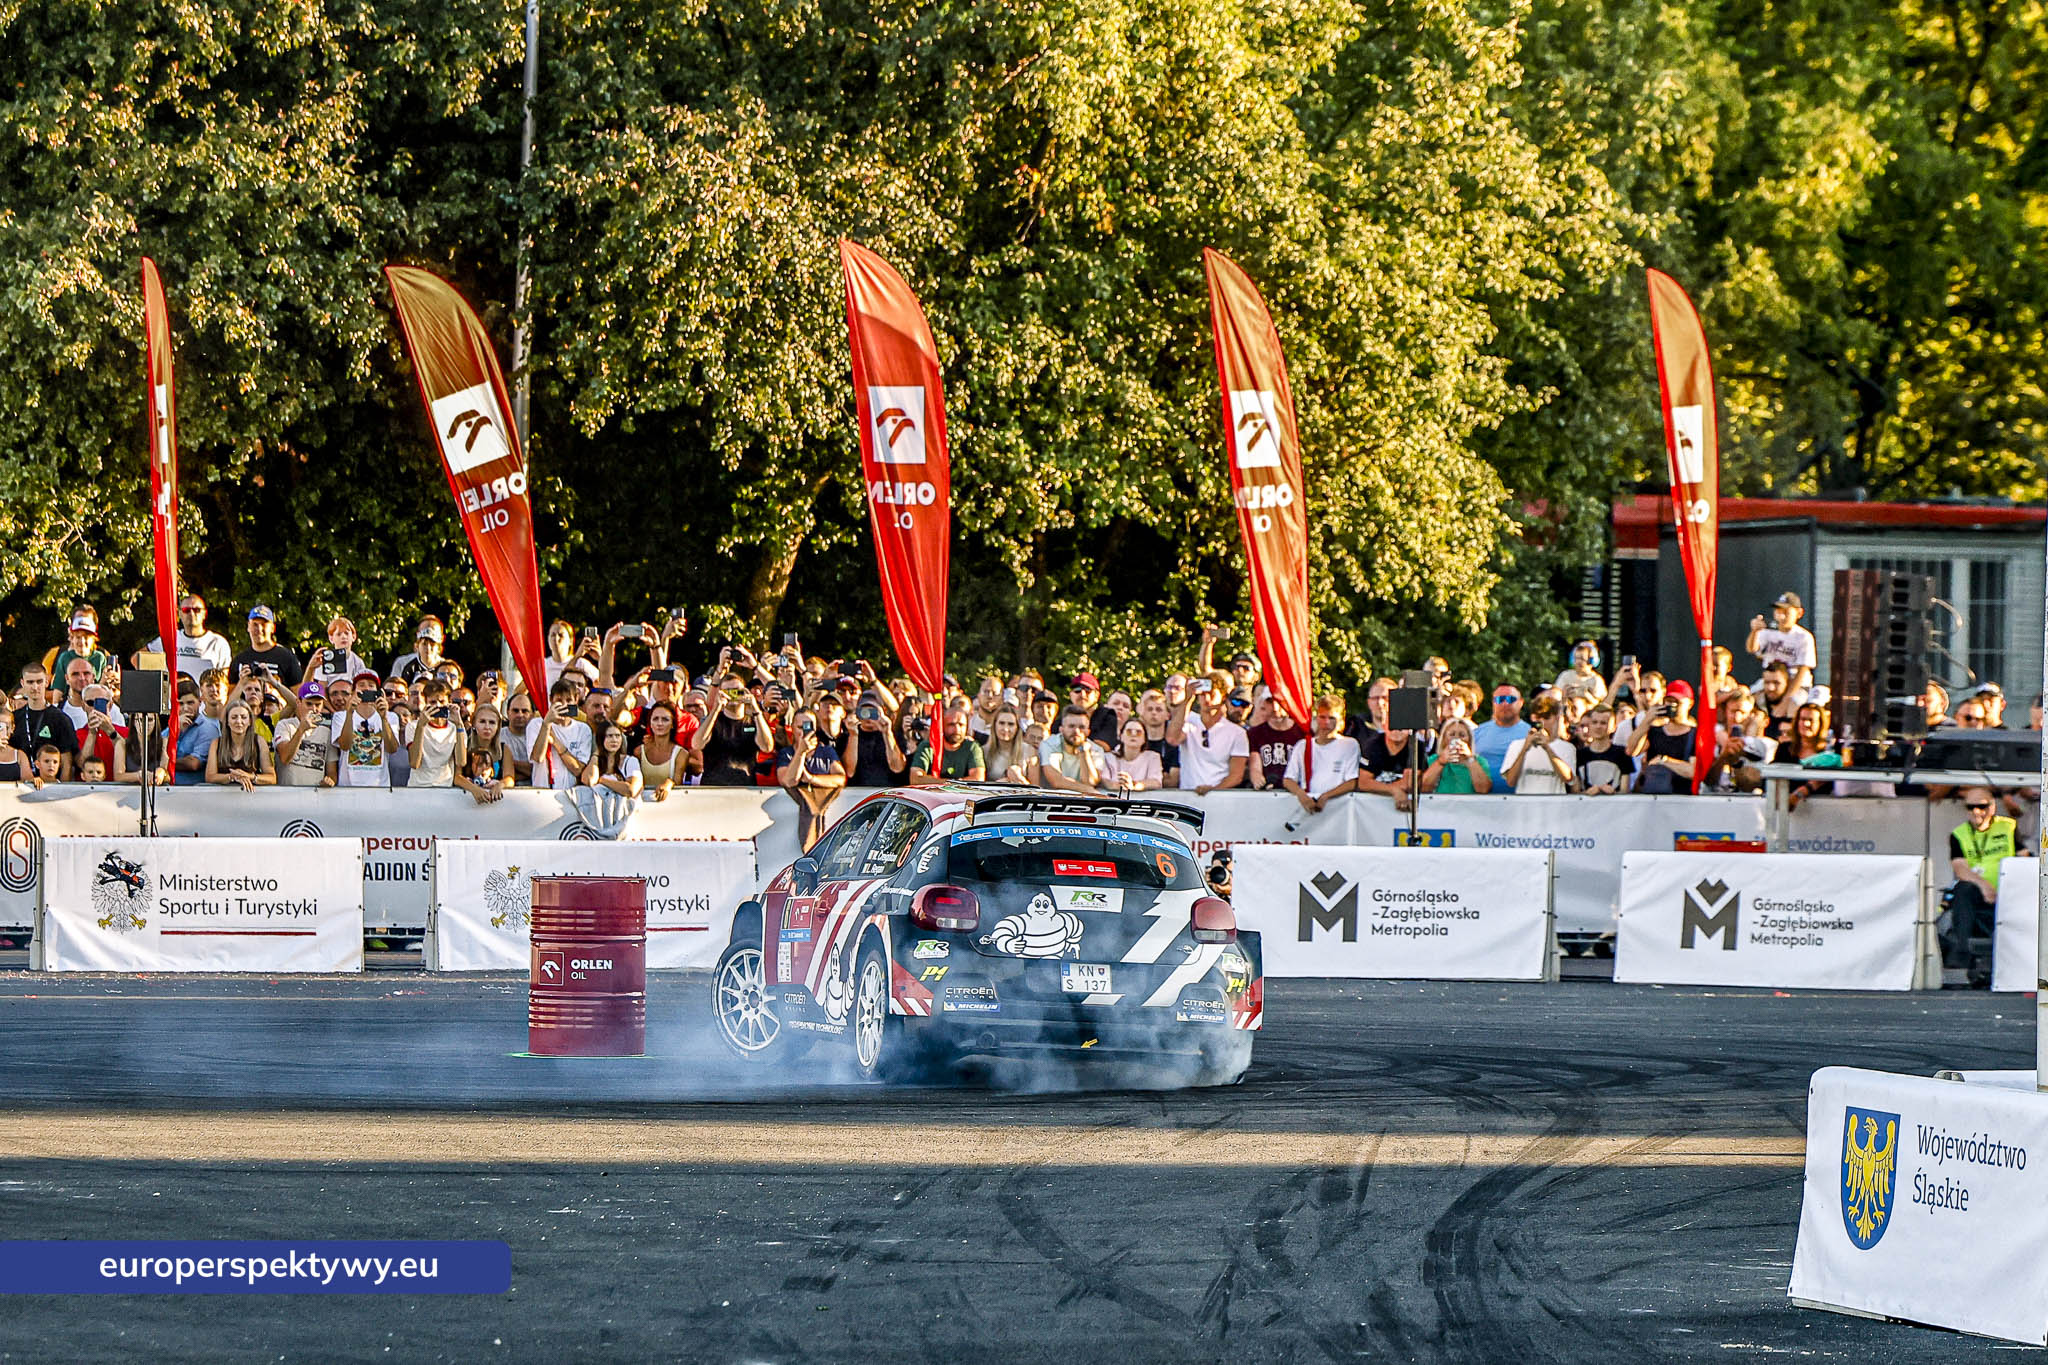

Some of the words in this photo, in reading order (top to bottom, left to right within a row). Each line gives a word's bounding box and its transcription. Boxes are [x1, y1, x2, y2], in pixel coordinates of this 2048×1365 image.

[1013, 827, 1051, 835] FOLLOW
[1069, 828, 1082, 836] ON
[1475, 832, 1595, 849] Województwo
[897, 832, 918, 868] 6
[1156, 853, 1177, 878] 6
[160, 874, 278, 892] Ministerstwo
[1372, 889, 1460, 906] Górnośląsko
[159, 898, 219, 919] Sportu
[225, 898, 230, 915] i
[235, 898, 318, 919] Turystyki
[1372, 906, 1480, 922] -Zagłębiowska
[1753, 898, 1835, 914] Górnośląsko
[1372, 922, 1449, 938] Metropolia
[1750, 932, 1824, 948] Metropolia
[570, 959, 613, 970] ORLEN
[1078, 965, 1094, 977] KN
[570, 971, 587, 980] OIL
[919, 965, 949, 982] P1
[945, 986, 994, 995] CITROËN
[1066, 979, 1074, 990] S
[1085, 980, 1107, 991] 137
[1183, 999, 1225, 1009] CITROËN
[1917, 1124, 2027, 1171] Województwo
[1912, 1167, 1969, 1215] Śląskie
